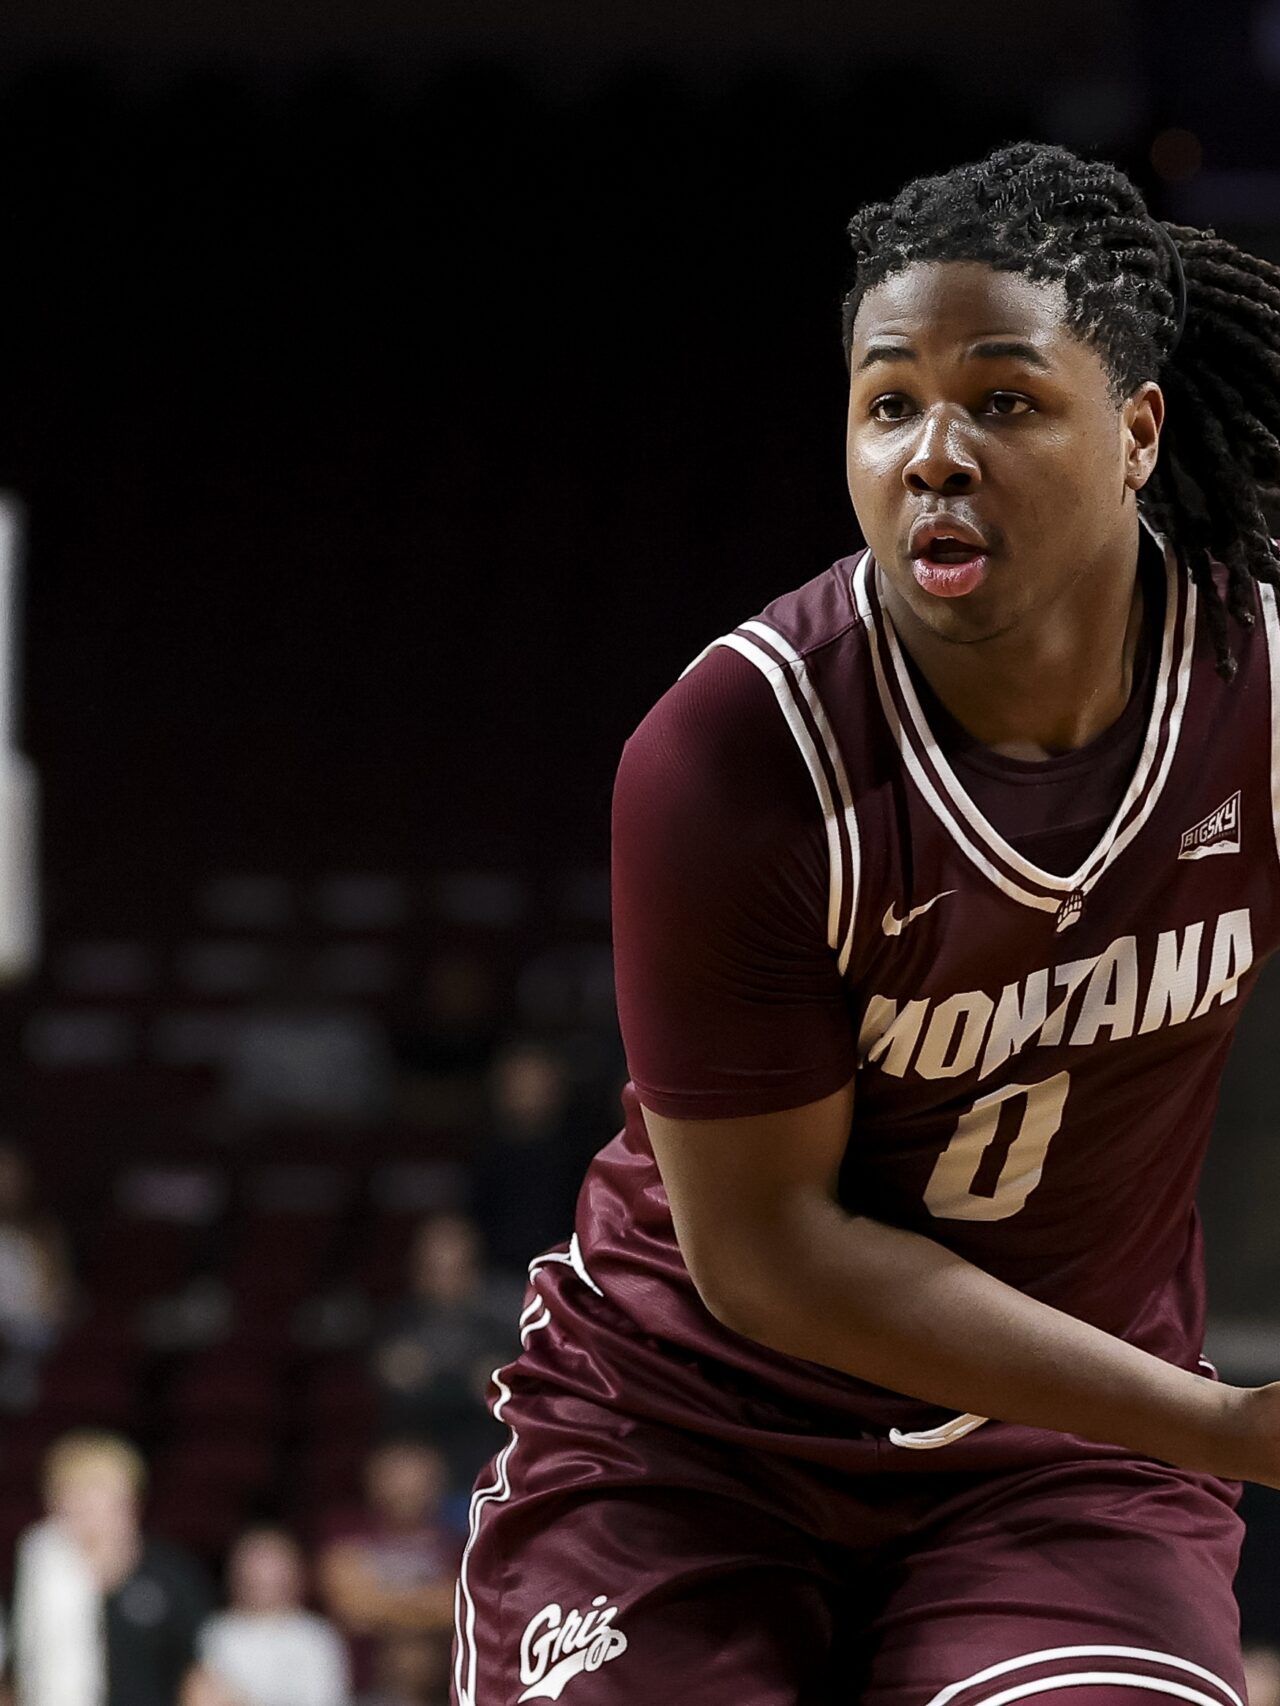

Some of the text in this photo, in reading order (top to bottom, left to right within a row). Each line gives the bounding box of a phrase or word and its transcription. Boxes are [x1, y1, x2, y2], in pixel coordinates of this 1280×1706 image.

[857, 907, 1255, 1082] MONTANA
[922, 1070, 1070, 1222] 0
[519, 1595, 628, 1688] Griz
